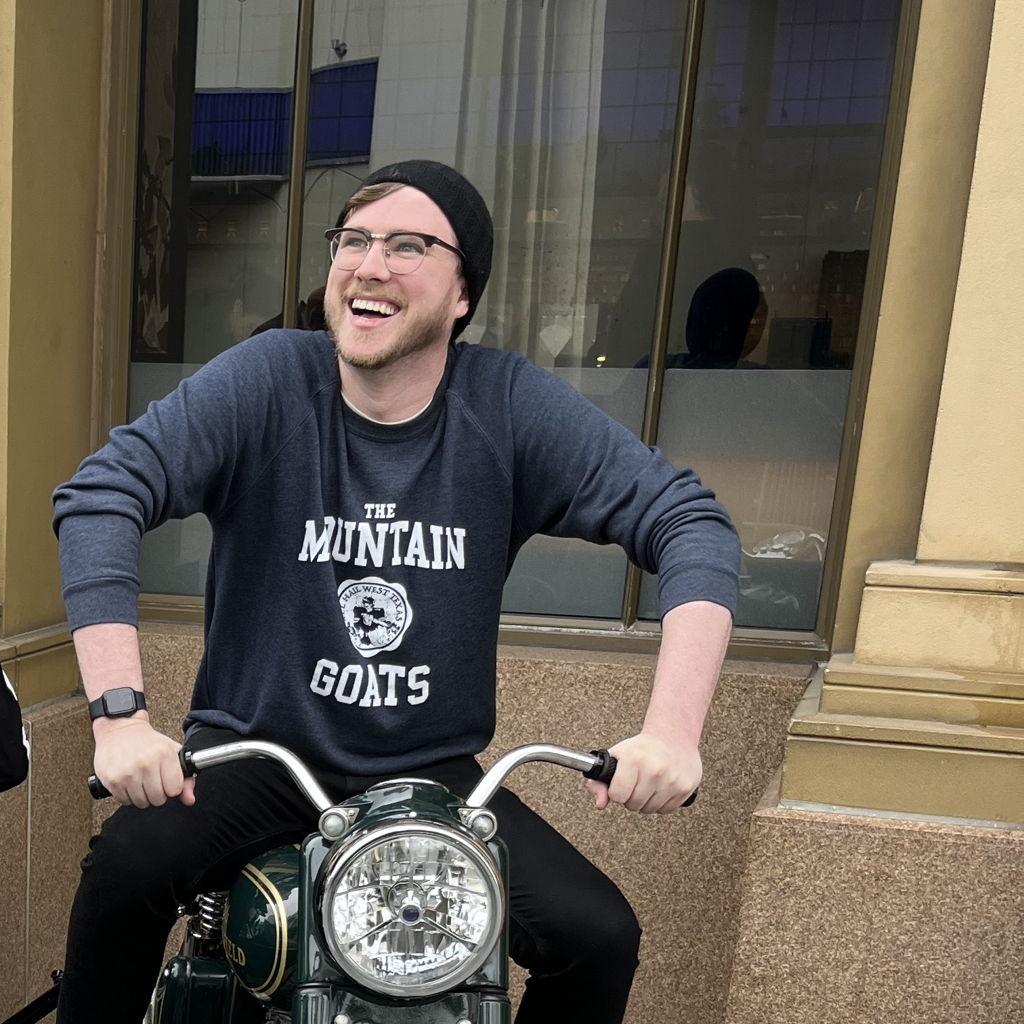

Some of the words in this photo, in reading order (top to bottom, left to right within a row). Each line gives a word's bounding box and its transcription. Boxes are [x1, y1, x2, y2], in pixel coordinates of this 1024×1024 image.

[364, 503, 396, 519] THE
[342, 585, 362, 602] HAIL
[362, 585, 391, 597] WEST
[390, 592, 404, 622] TEXAS
[309, 658, 431, 708] GOATS
